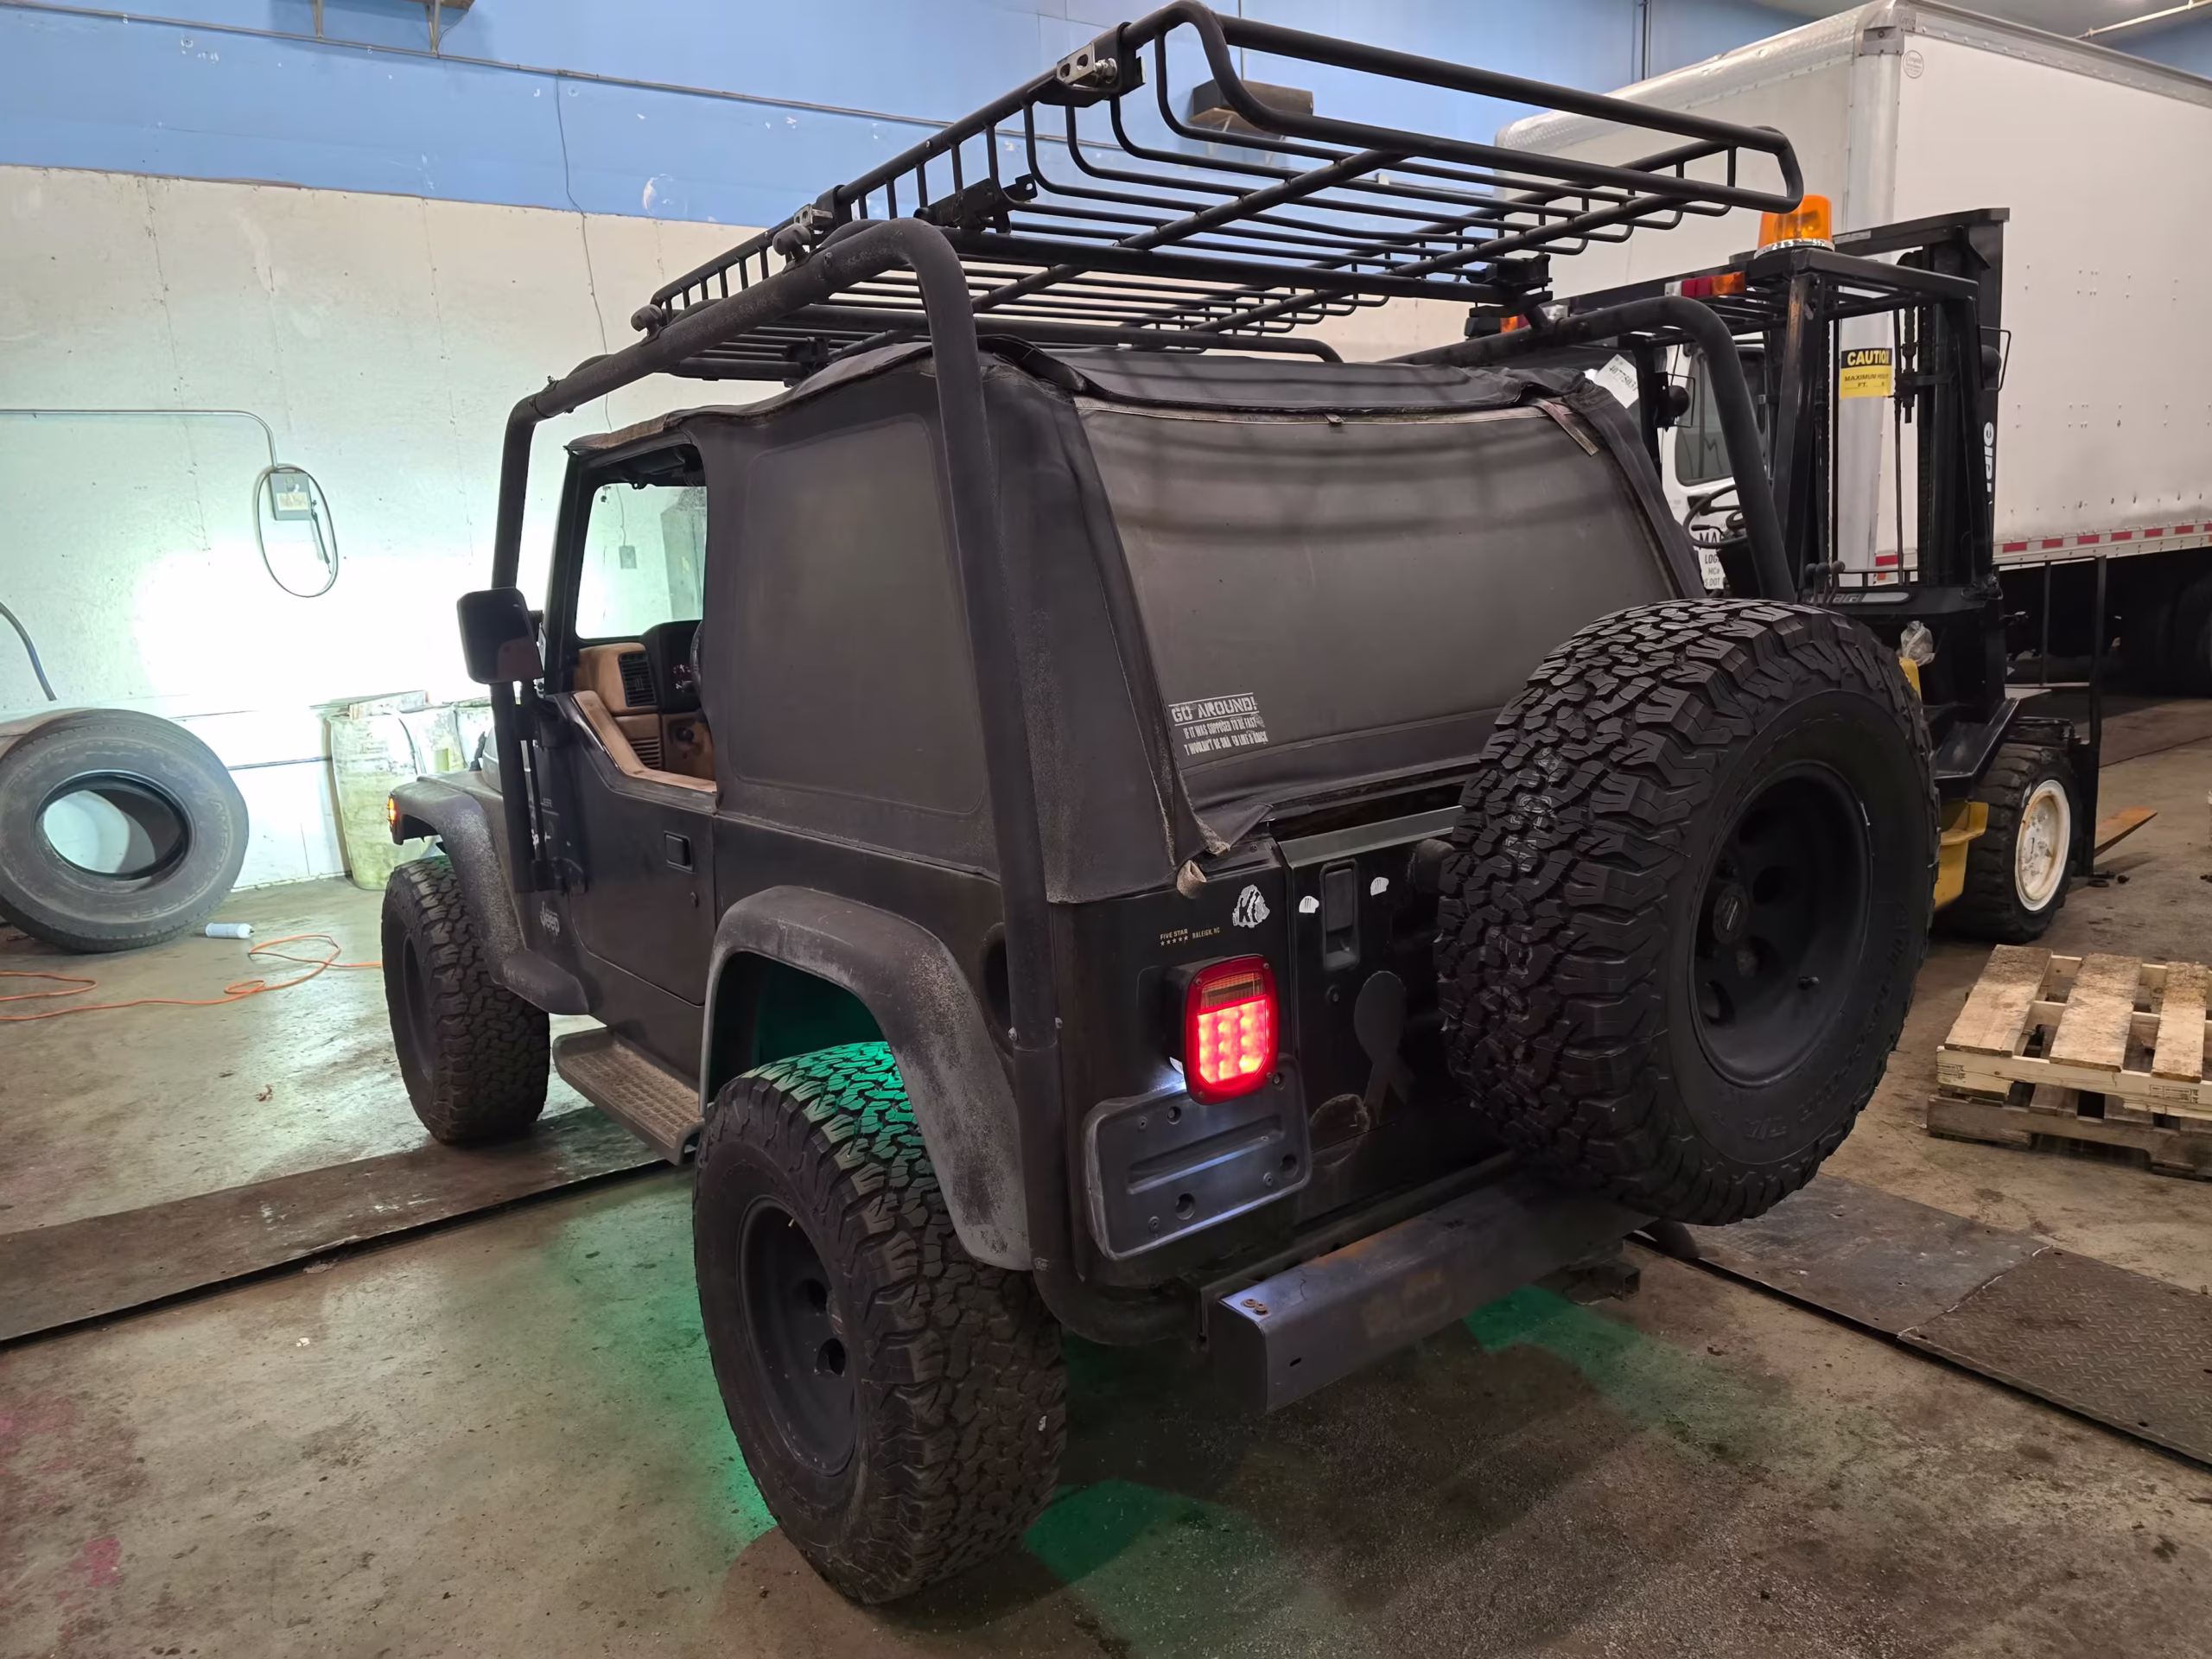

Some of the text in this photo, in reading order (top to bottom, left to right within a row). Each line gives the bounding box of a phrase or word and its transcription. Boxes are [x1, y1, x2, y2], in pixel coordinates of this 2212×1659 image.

[1705, 554, 1720, 564] LOG
[1709, 577, 1720, 586] DOT
[1172, 696, 1258, 722] GO AROUND!
[1183, 728, 1190, 739] IF
[1188, 727, 1196, 738] IT
[1194, 724, 1209, 736] WAS
[1207, 720, 1232, 734] SUPPOSED
[1230, 719, 1239, 730] TO
[1243, 717, 1257, 728] FAST
[1213, 738, 1222, 749] BE
